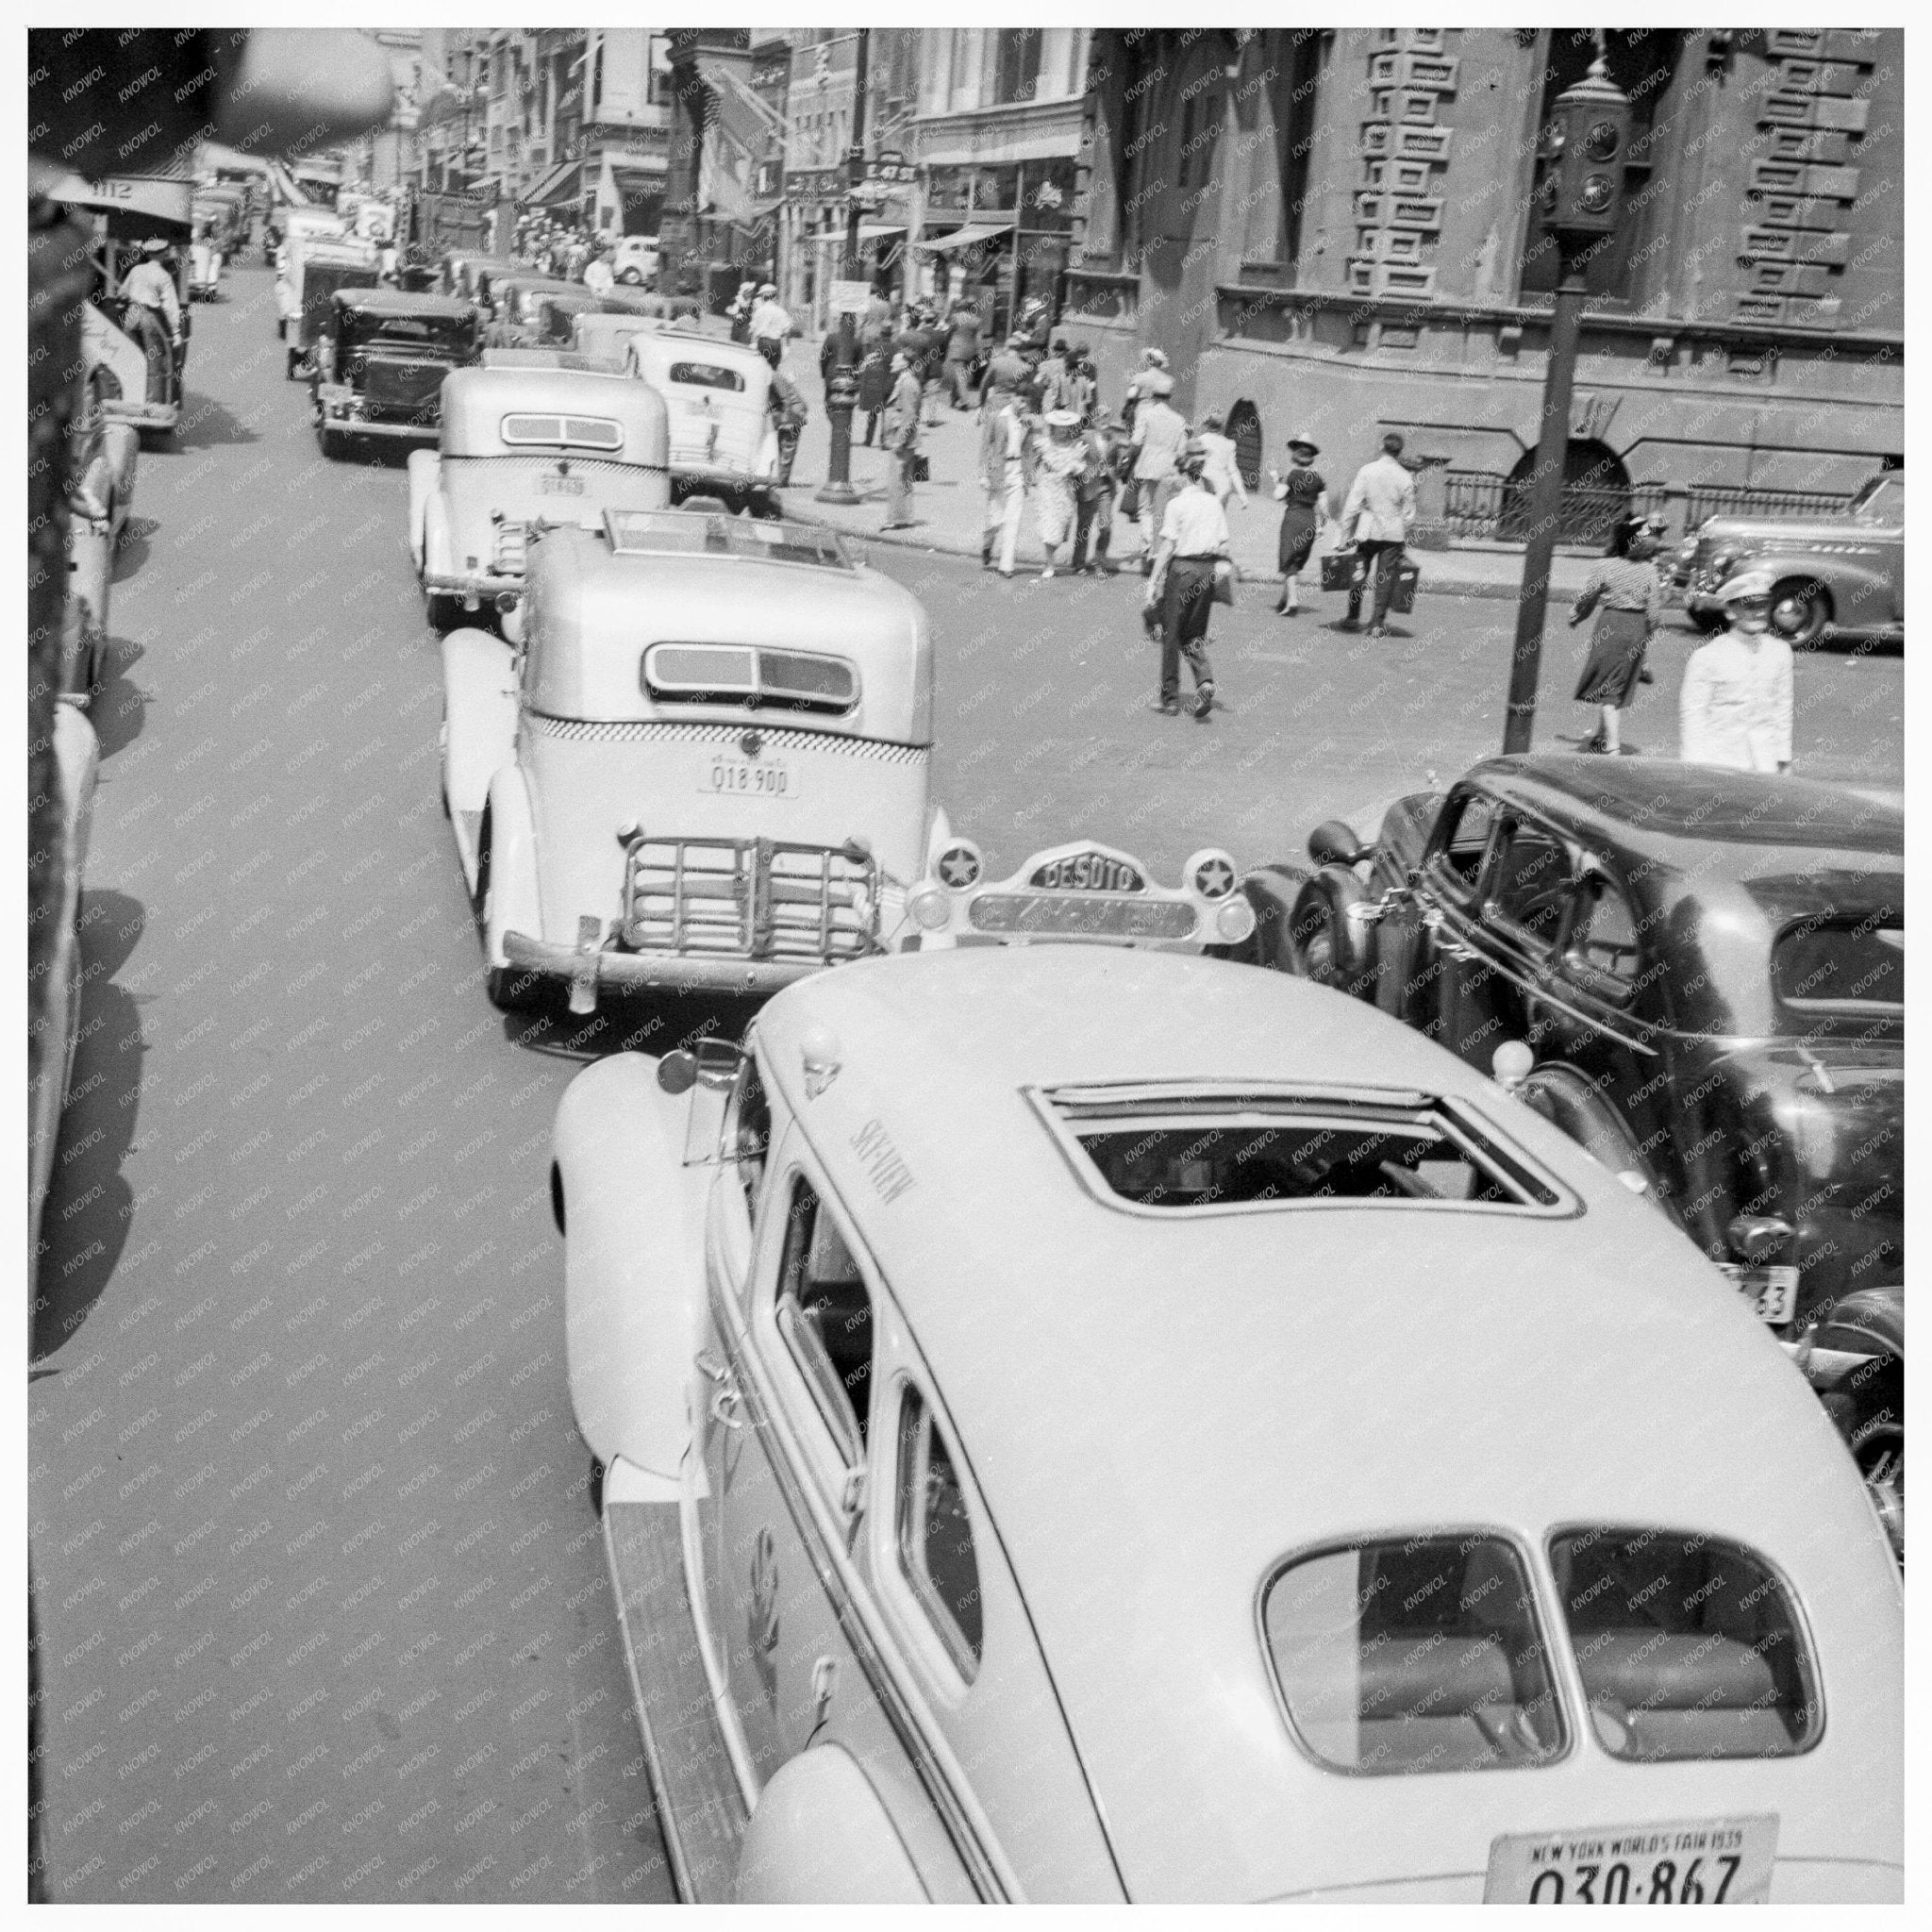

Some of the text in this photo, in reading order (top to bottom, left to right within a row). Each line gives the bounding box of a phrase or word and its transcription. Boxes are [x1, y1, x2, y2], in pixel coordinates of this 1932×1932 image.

[1043, 855, 1132, 890] DESOTO
[1532, 1843, 1563, 1863] NEW
[1570, 1840, 1604, 1860] YORK
[1674, 1832, 1707, 1853] FAIR
